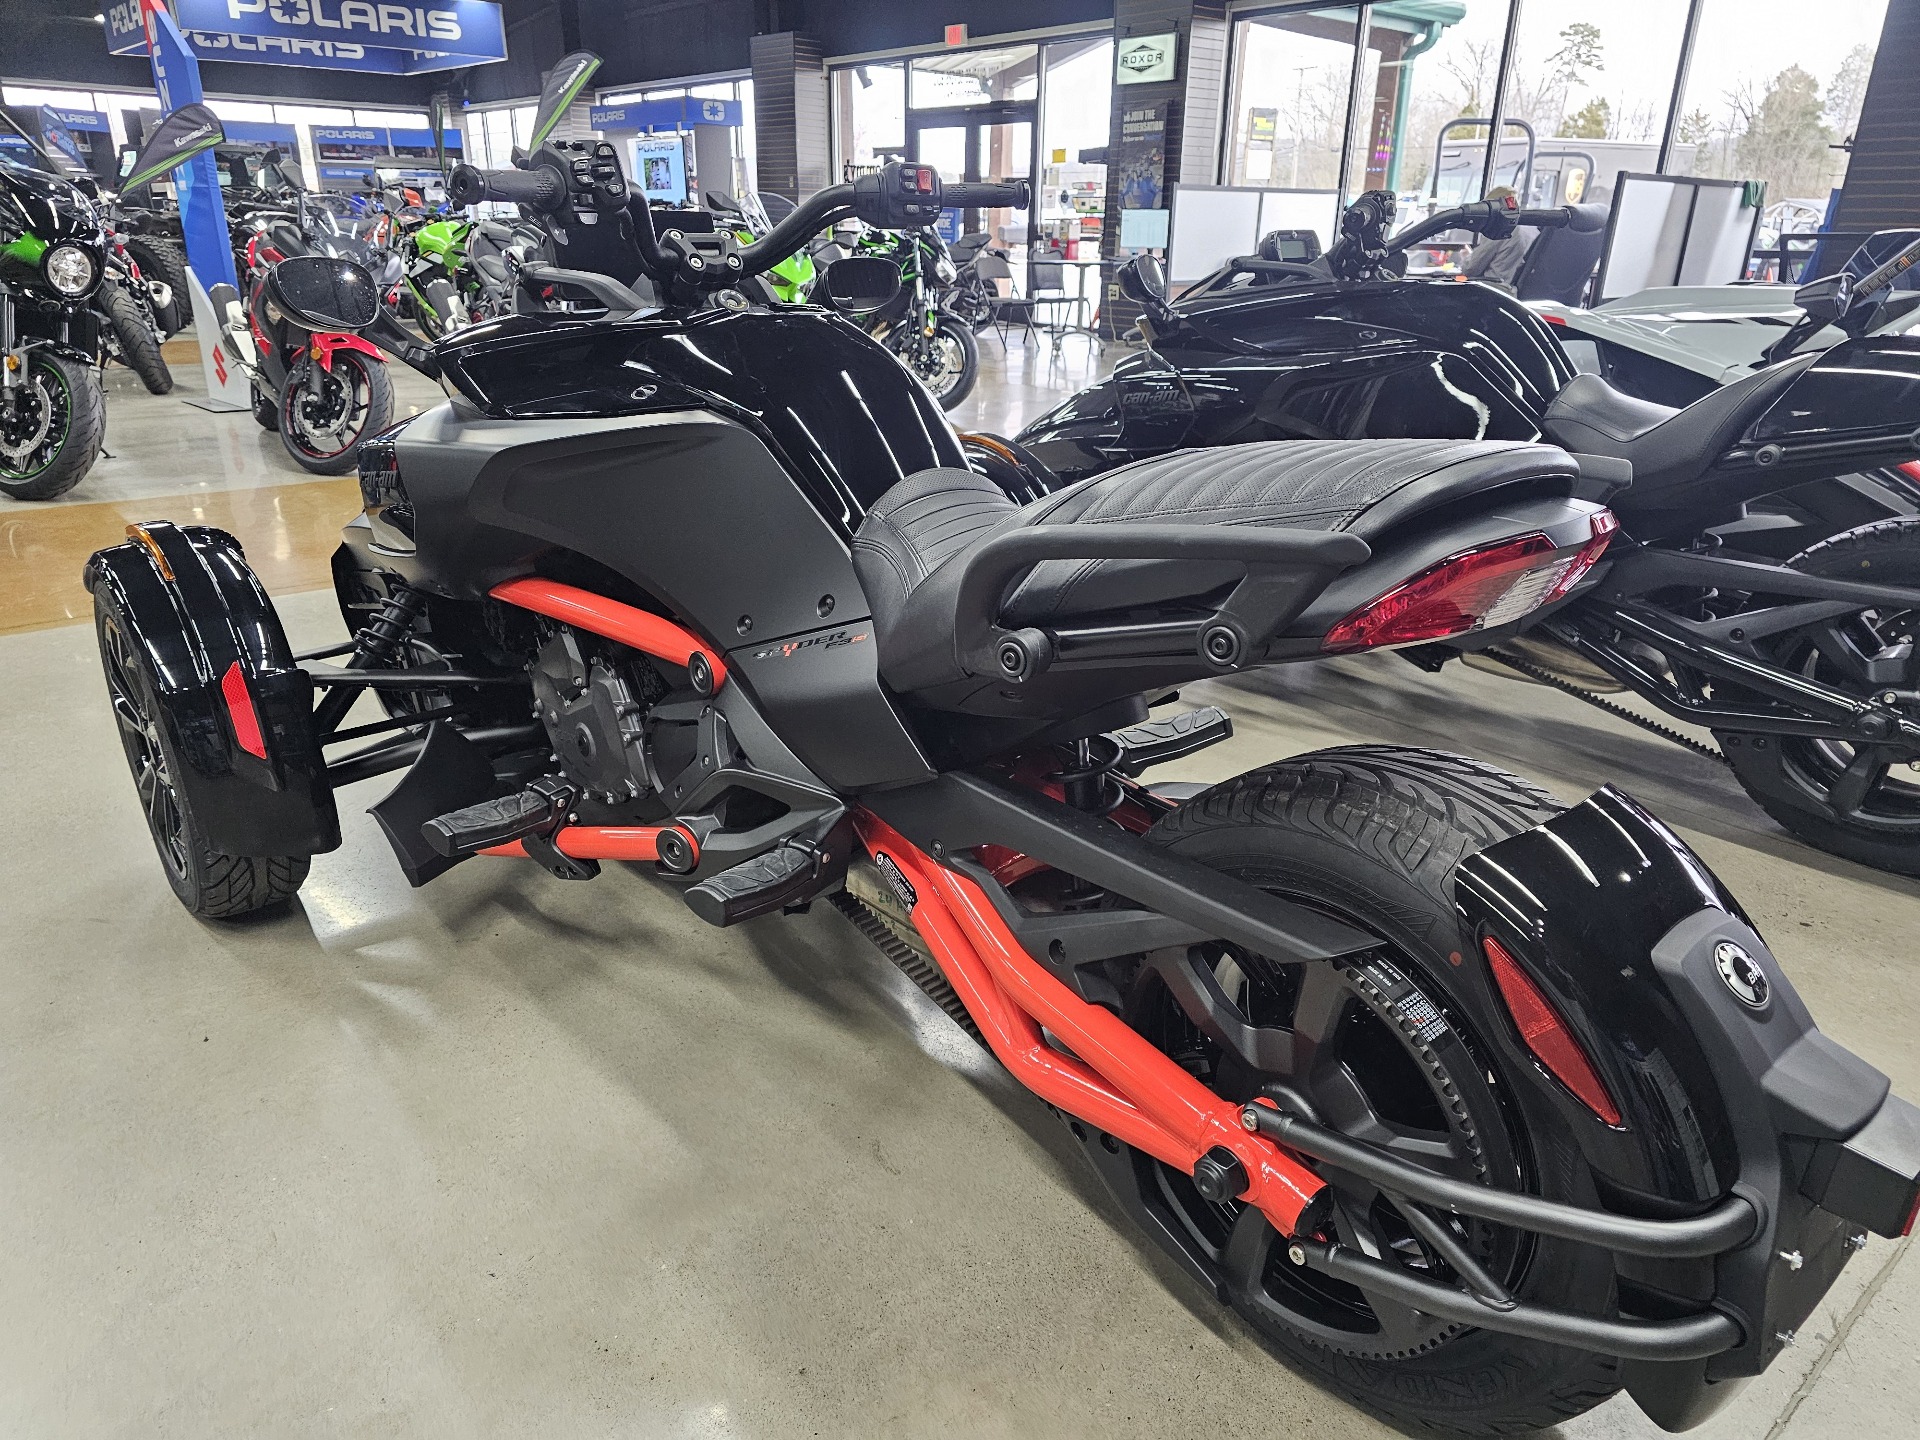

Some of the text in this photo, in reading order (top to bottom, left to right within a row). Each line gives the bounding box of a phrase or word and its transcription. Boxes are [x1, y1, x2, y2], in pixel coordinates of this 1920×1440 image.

[226, 0, 462, 41] POLARIS
[1122, 52, 1163, 65] ROXOR
[57, 112, 98, 125] LARIS
[592, 110, 625, 123] POLARIS
[173, 122, 213, 148] Kawasaki
[315, 129, 376, 140] POLARIS
[637, 141, 675, 154] POLARIS
[1122, 390, 1180, 405] can-am
